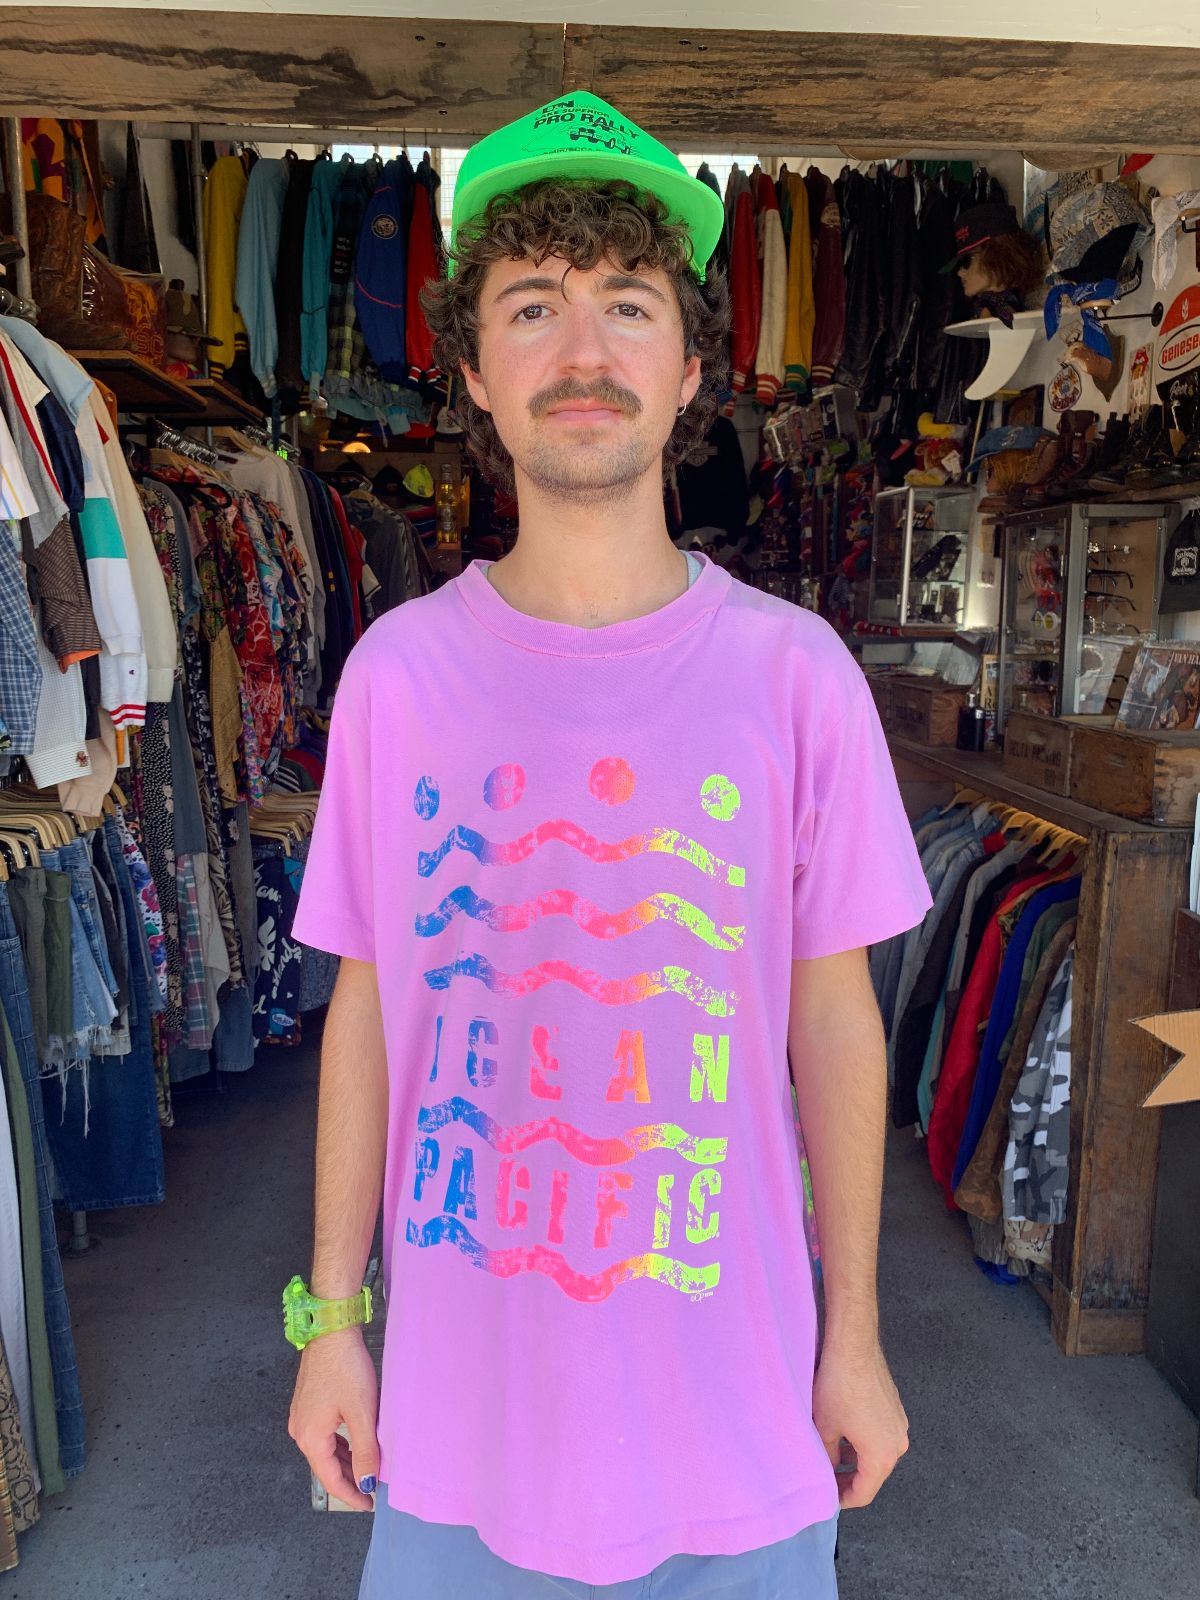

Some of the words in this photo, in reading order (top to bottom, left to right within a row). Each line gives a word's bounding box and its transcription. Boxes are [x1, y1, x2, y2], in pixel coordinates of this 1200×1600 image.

[533, 112, 575, 129] PRO
[580, 113, 640, 139] RALLY
[561, 107, 610, 120] SUPERIOR
[1161, 333, 1200, 366] Genese
[413, 1136, 722, 1250] PACIFIC
